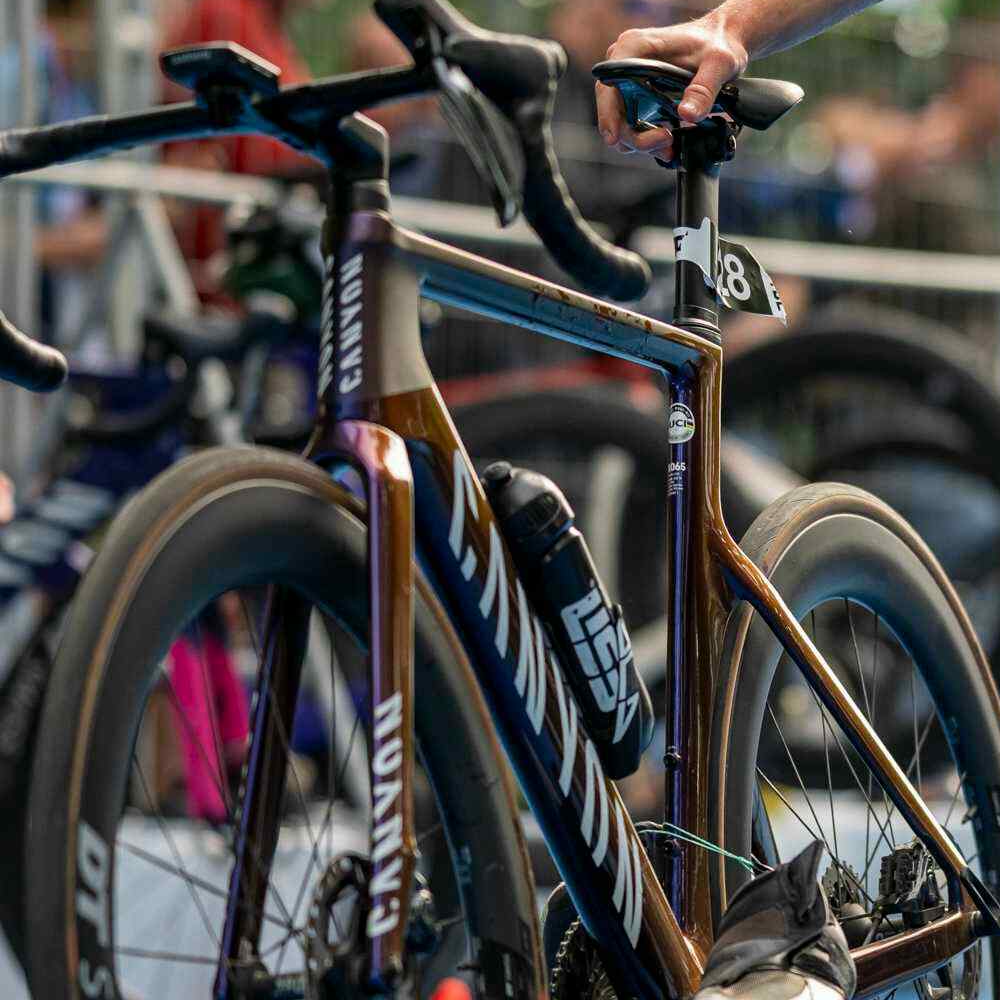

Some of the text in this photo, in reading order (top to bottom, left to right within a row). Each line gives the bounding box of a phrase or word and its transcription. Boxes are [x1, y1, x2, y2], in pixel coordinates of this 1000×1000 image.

[339, 253, 364, 394] CANYON
[448, 449, 643, 949] CANYON
[76, 820, 110, 947] DT
[366, 691, 403, 938] CANYON
